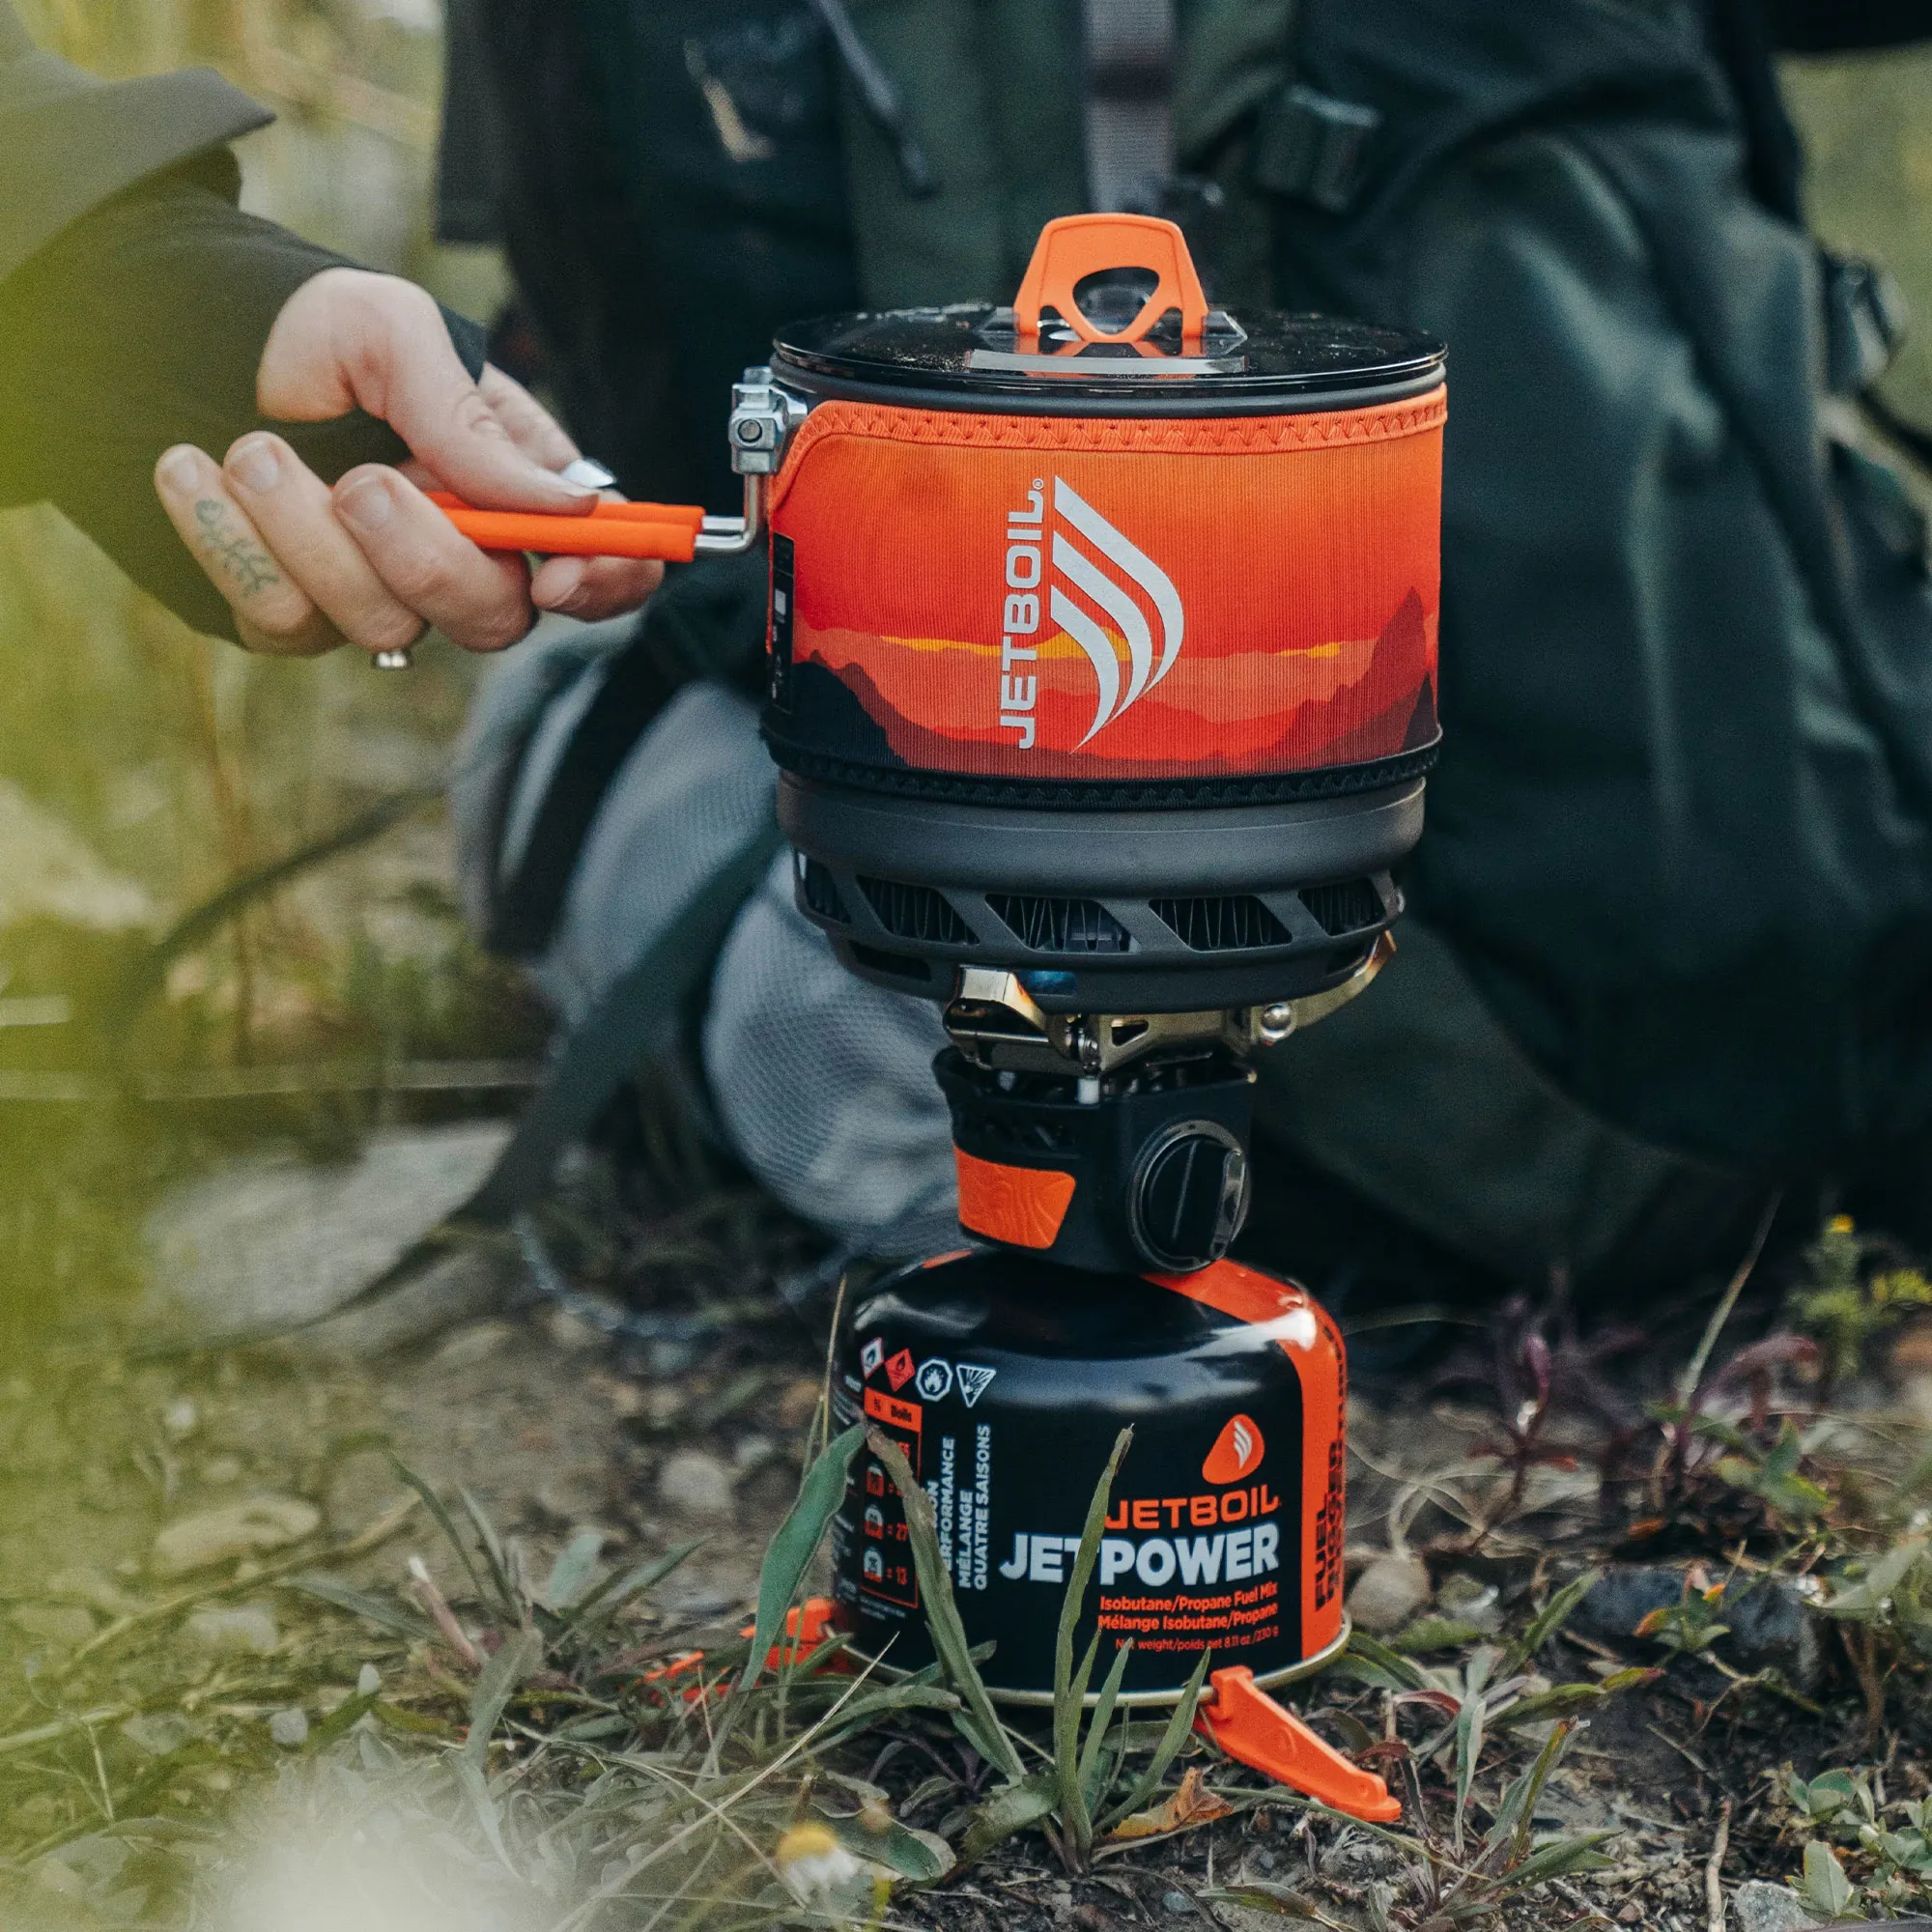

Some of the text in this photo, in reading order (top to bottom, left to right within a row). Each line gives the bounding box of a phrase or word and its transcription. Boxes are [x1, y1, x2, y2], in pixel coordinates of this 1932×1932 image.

[940, 1436, 954, 1572] ERFORMANCE
[974, 1423, 990, 1590] QUATRE SAISONS
[1104, 1484, 1279, 1529] JETBOIL
[956, 1490, 973, 1588] MÉLANGE
[1097, 1603, 1278, 1633] Mélange Isobutane/Propane
[1100, 1580, 1278, 1612] Isobutane/Propane Fuel Mix
[1137, 1637, 1205, 1652] weight/poids
